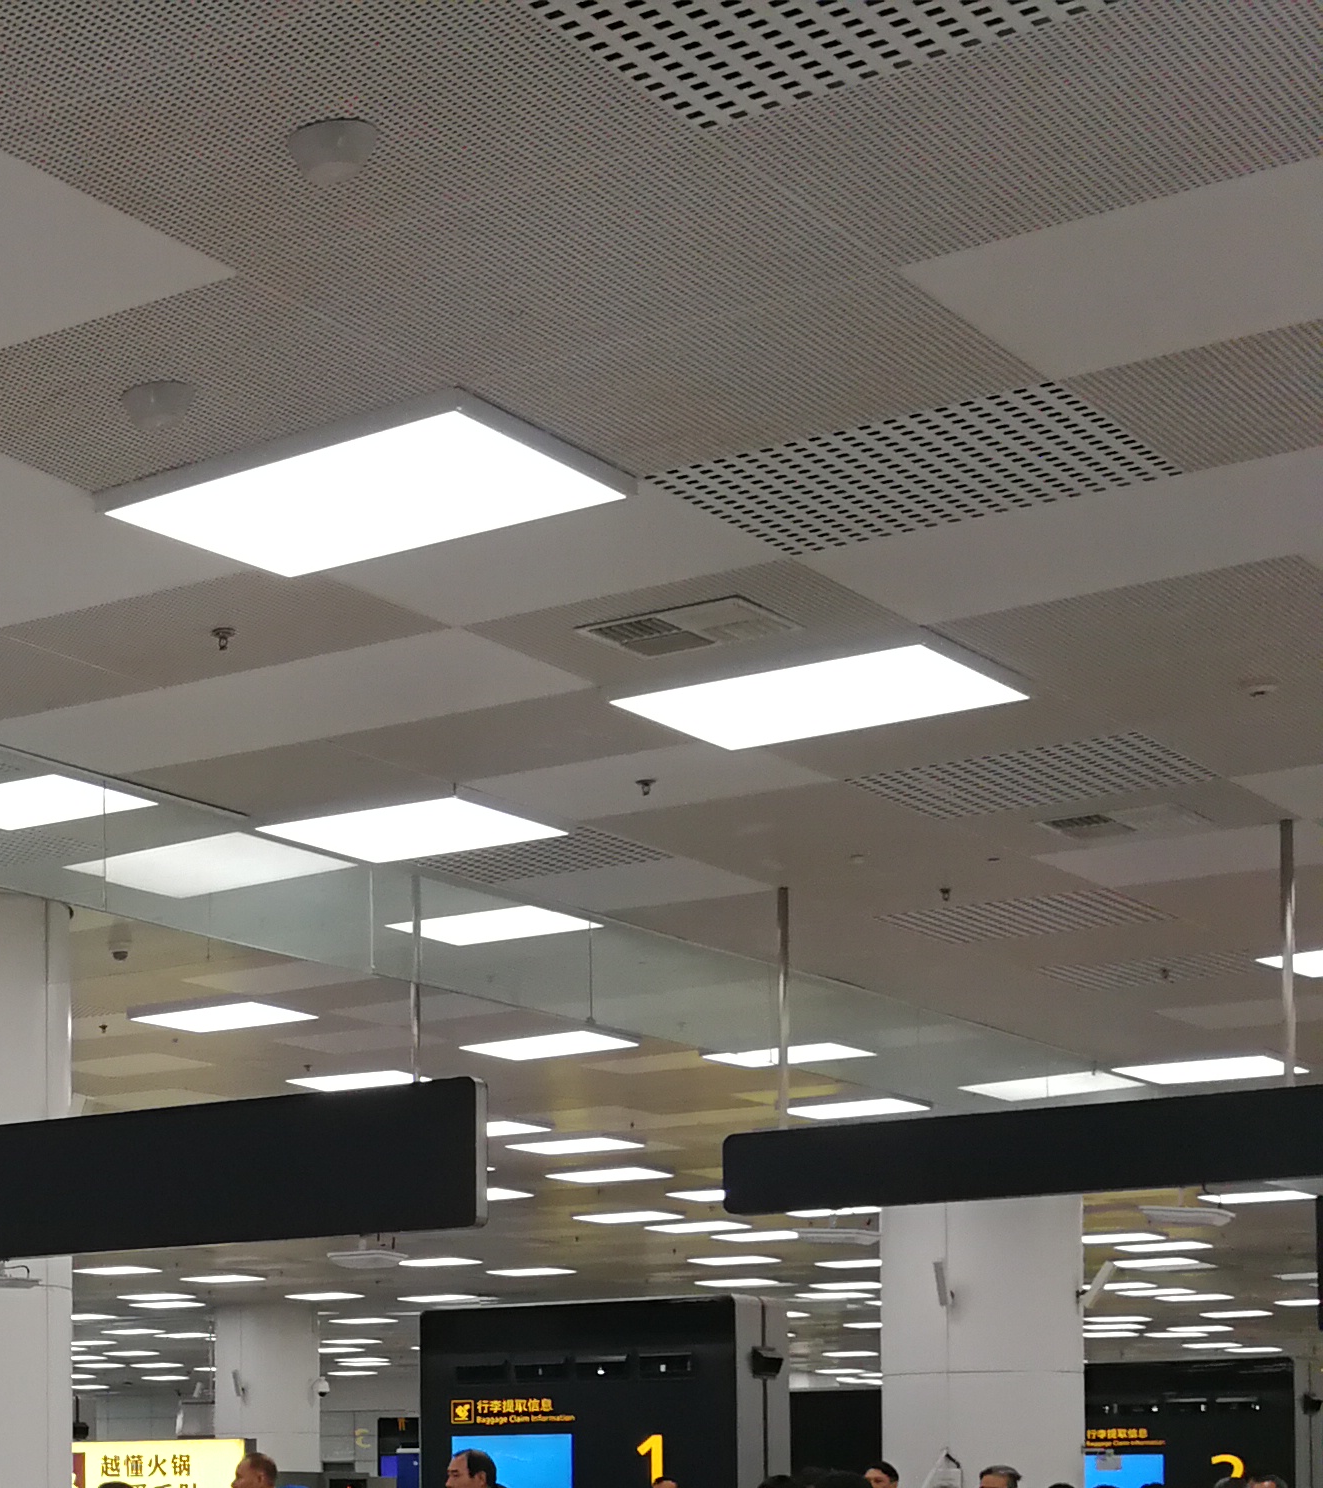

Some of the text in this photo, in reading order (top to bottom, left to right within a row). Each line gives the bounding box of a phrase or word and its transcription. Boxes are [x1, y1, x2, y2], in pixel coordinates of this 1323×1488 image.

[476, 1398, 554, 1414] 行李提取信息
[100, 1453, 191, 1478] 越懂火锅
